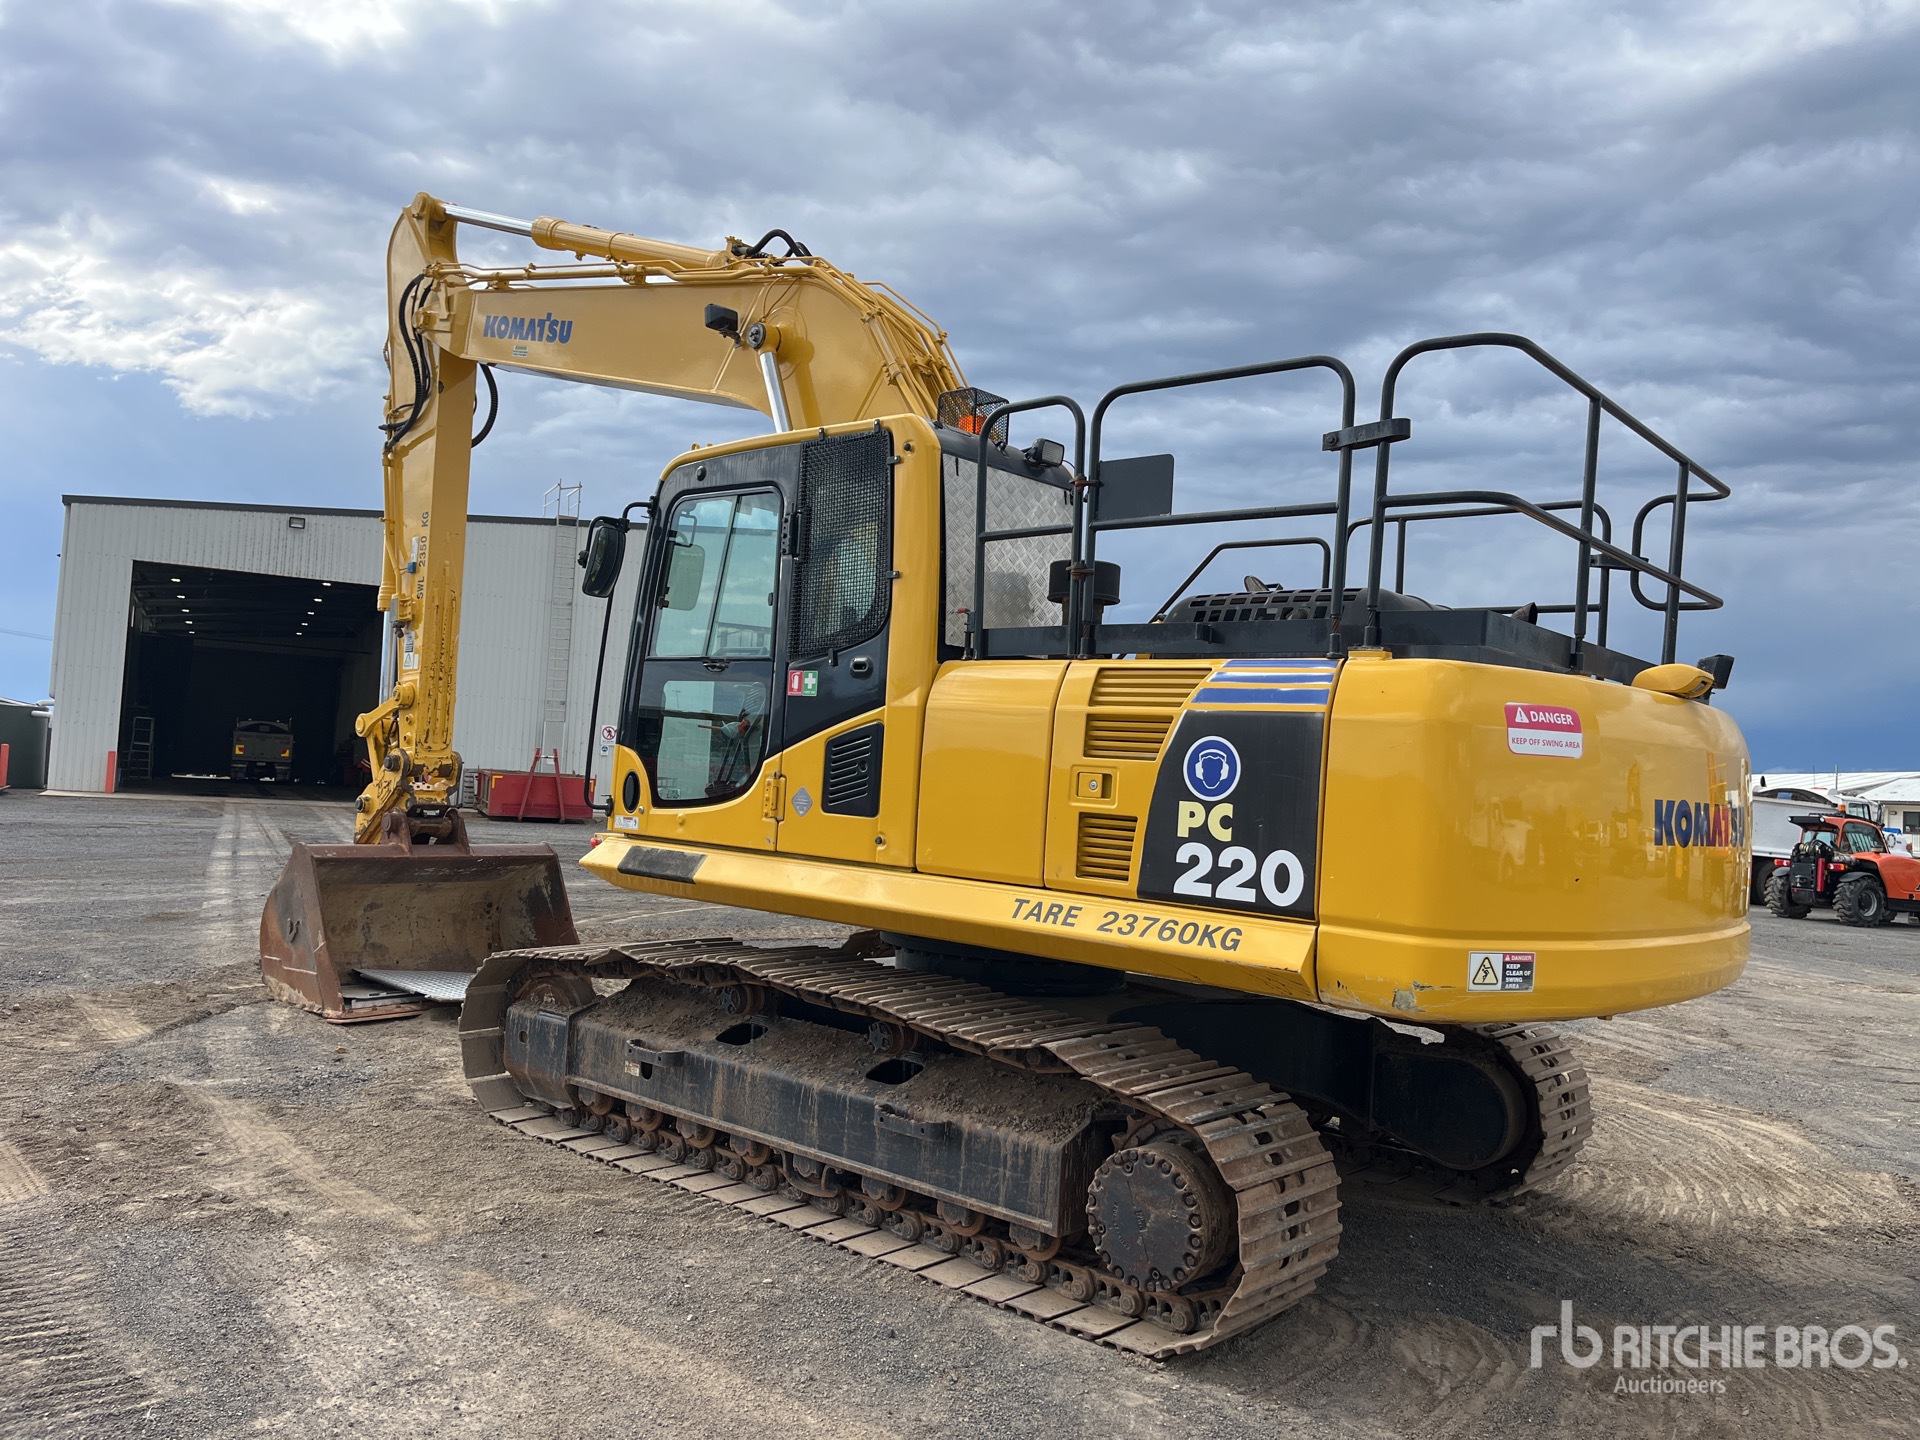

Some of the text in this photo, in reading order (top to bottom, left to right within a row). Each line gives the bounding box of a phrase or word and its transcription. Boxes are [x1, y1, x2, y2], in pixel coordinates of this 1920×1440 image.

[483, 312, 573, 344] KOMATSU
[416, 511, 430, 600] SWL 2350 KG
[1529, 710, 1574, 725] DANGER
[1511, 737, 1581, 749] KEEP OFF SWING AREA
[1177, 800, 1234, 842] PC
[1173, 841, 1305, 907] 220
[1011, 898, 1243, 952] TARE 23760KG
